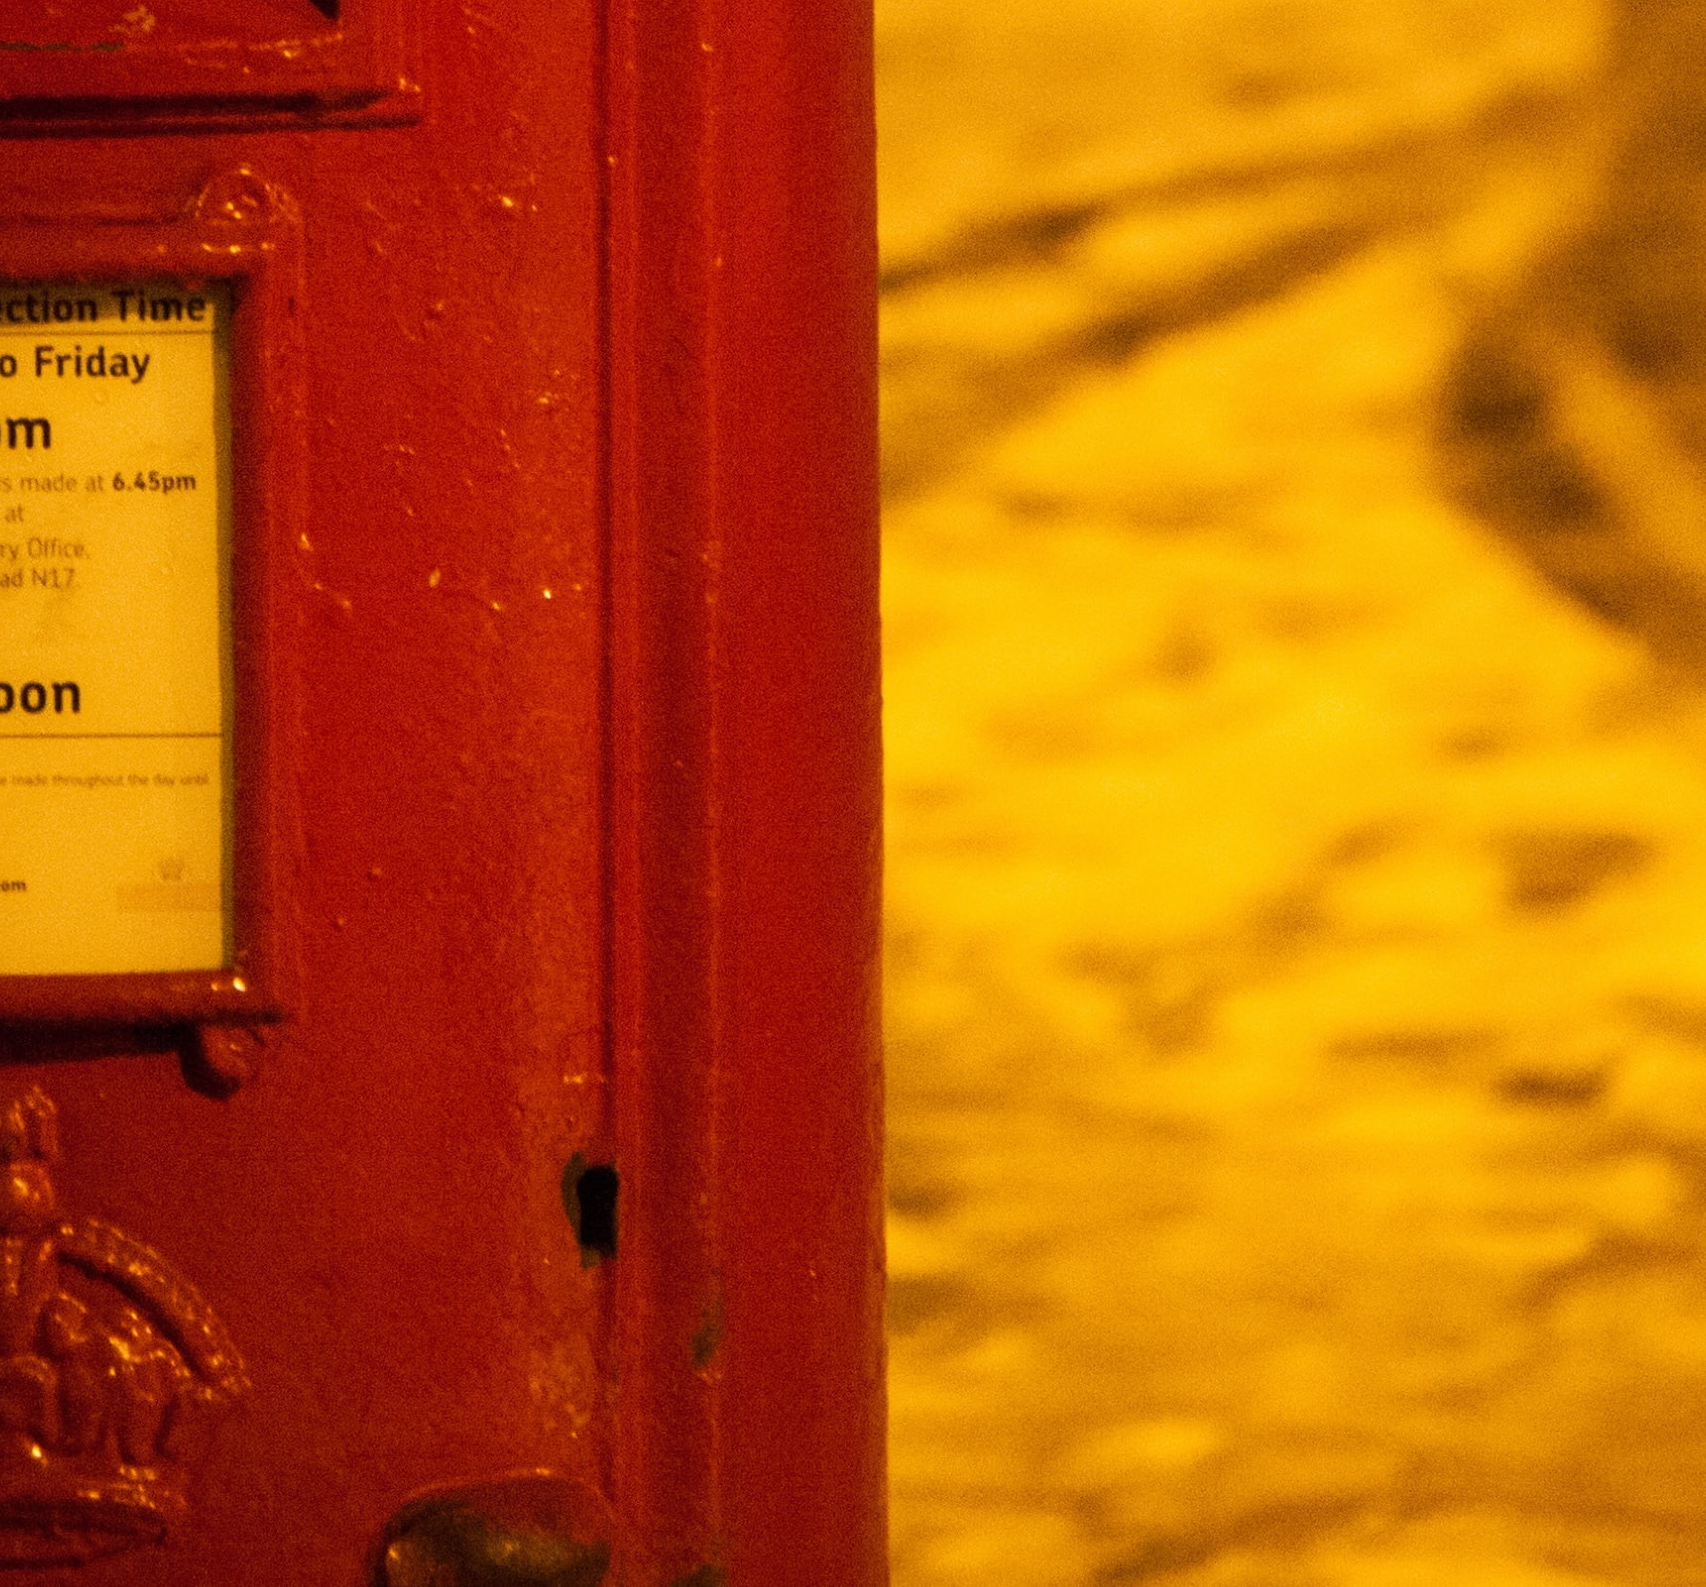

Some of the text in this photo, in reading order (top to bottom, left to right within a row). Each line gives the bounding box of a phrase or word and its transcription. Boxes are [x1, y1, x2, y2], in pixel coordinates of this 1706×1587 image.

[112, 290, 206, 321] Time
[35, 345, 150, 384] Friday
[20, 473, 77, 493] made
[85, 474, 104, 493] at
[112, 471, 197, 495] 6.45pm
[4, 504, 24, 523] at
